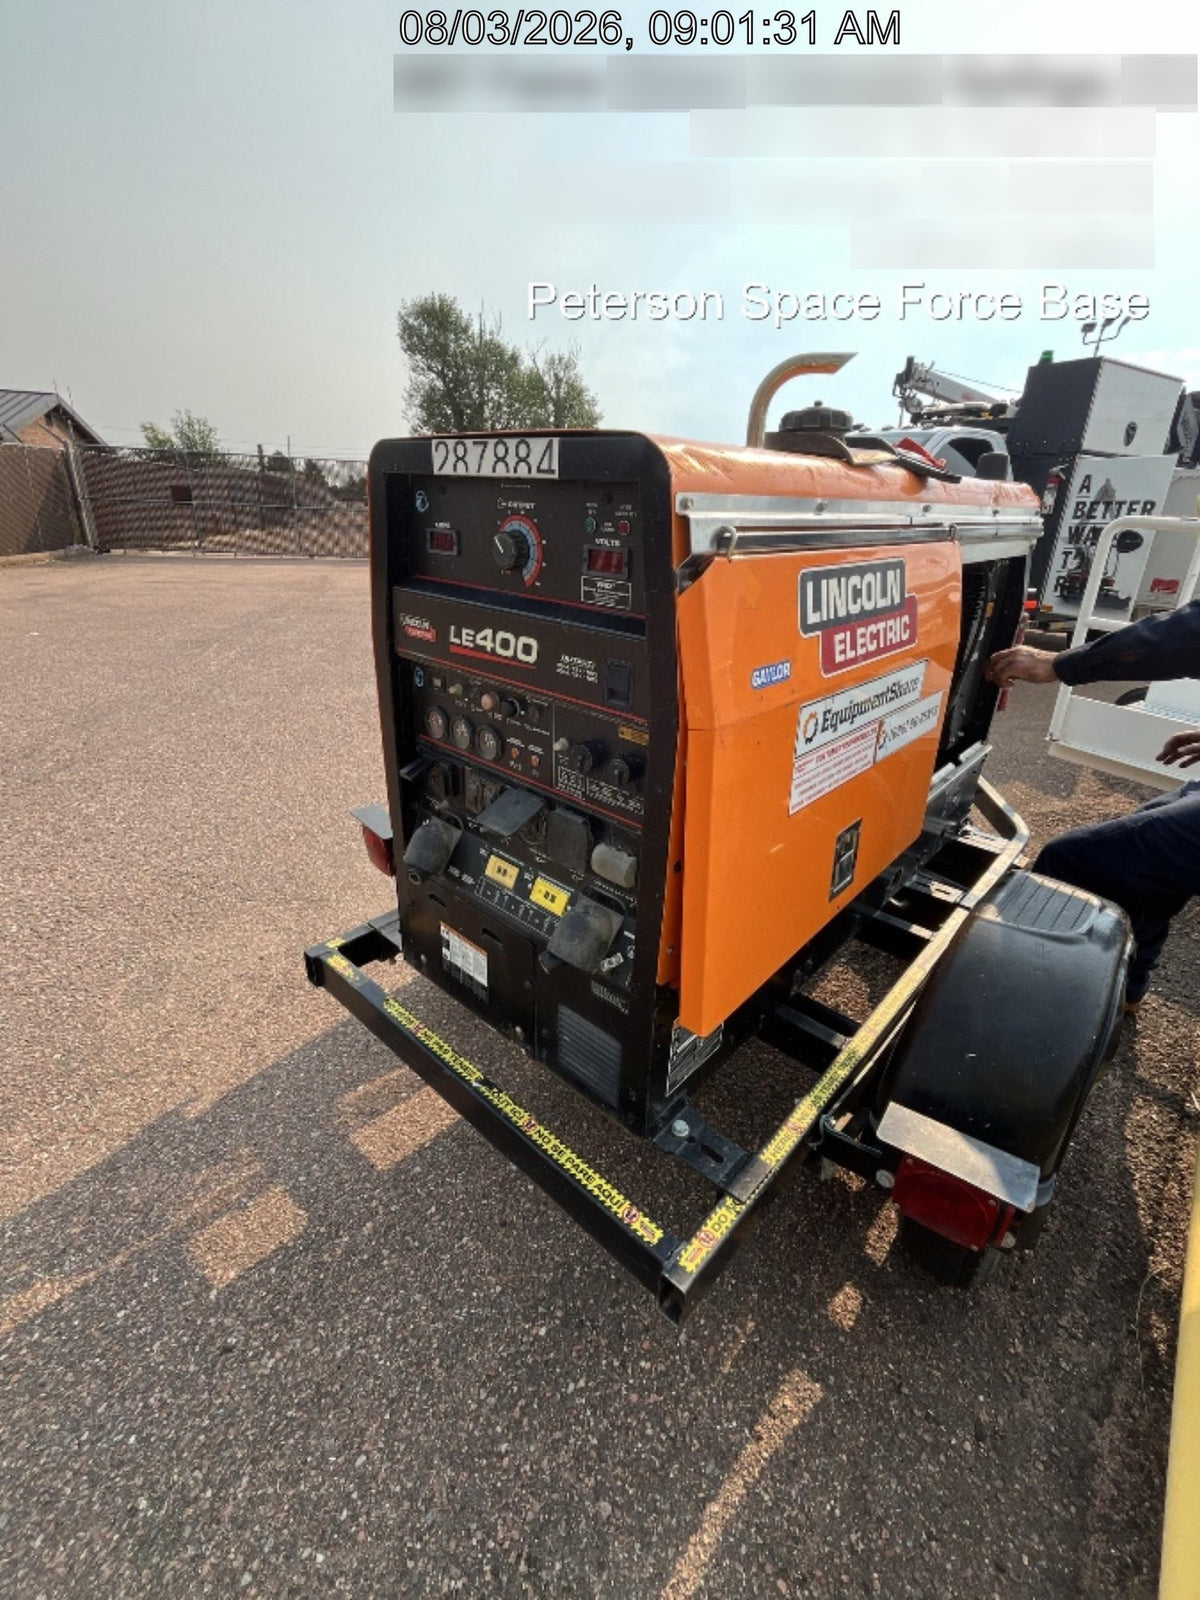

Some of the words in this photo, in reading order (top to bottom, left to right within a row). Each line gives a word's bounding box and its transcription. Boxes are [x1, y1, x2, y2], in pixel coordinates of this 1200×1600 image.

[434, 438, 557, 475] 287884
[1078, 473, 1093, 494] A
[1072, 499, 1157, 520] BETTER
[1067, 526, 1104, 545] WA
[806, 568, 901, 625] LINCOLN
[449, 624, 539, 664] LE400
[833, 614, 911, 664] ELECTRIC
[820, 677, 921, 734] EquipmentShare
[534, 1131, 552, 1145] NO
[550, 1143, 566, 1158] SE
[564, 1156, 596, 1184] PARE
[710, 1213, 728, 1233] DO
